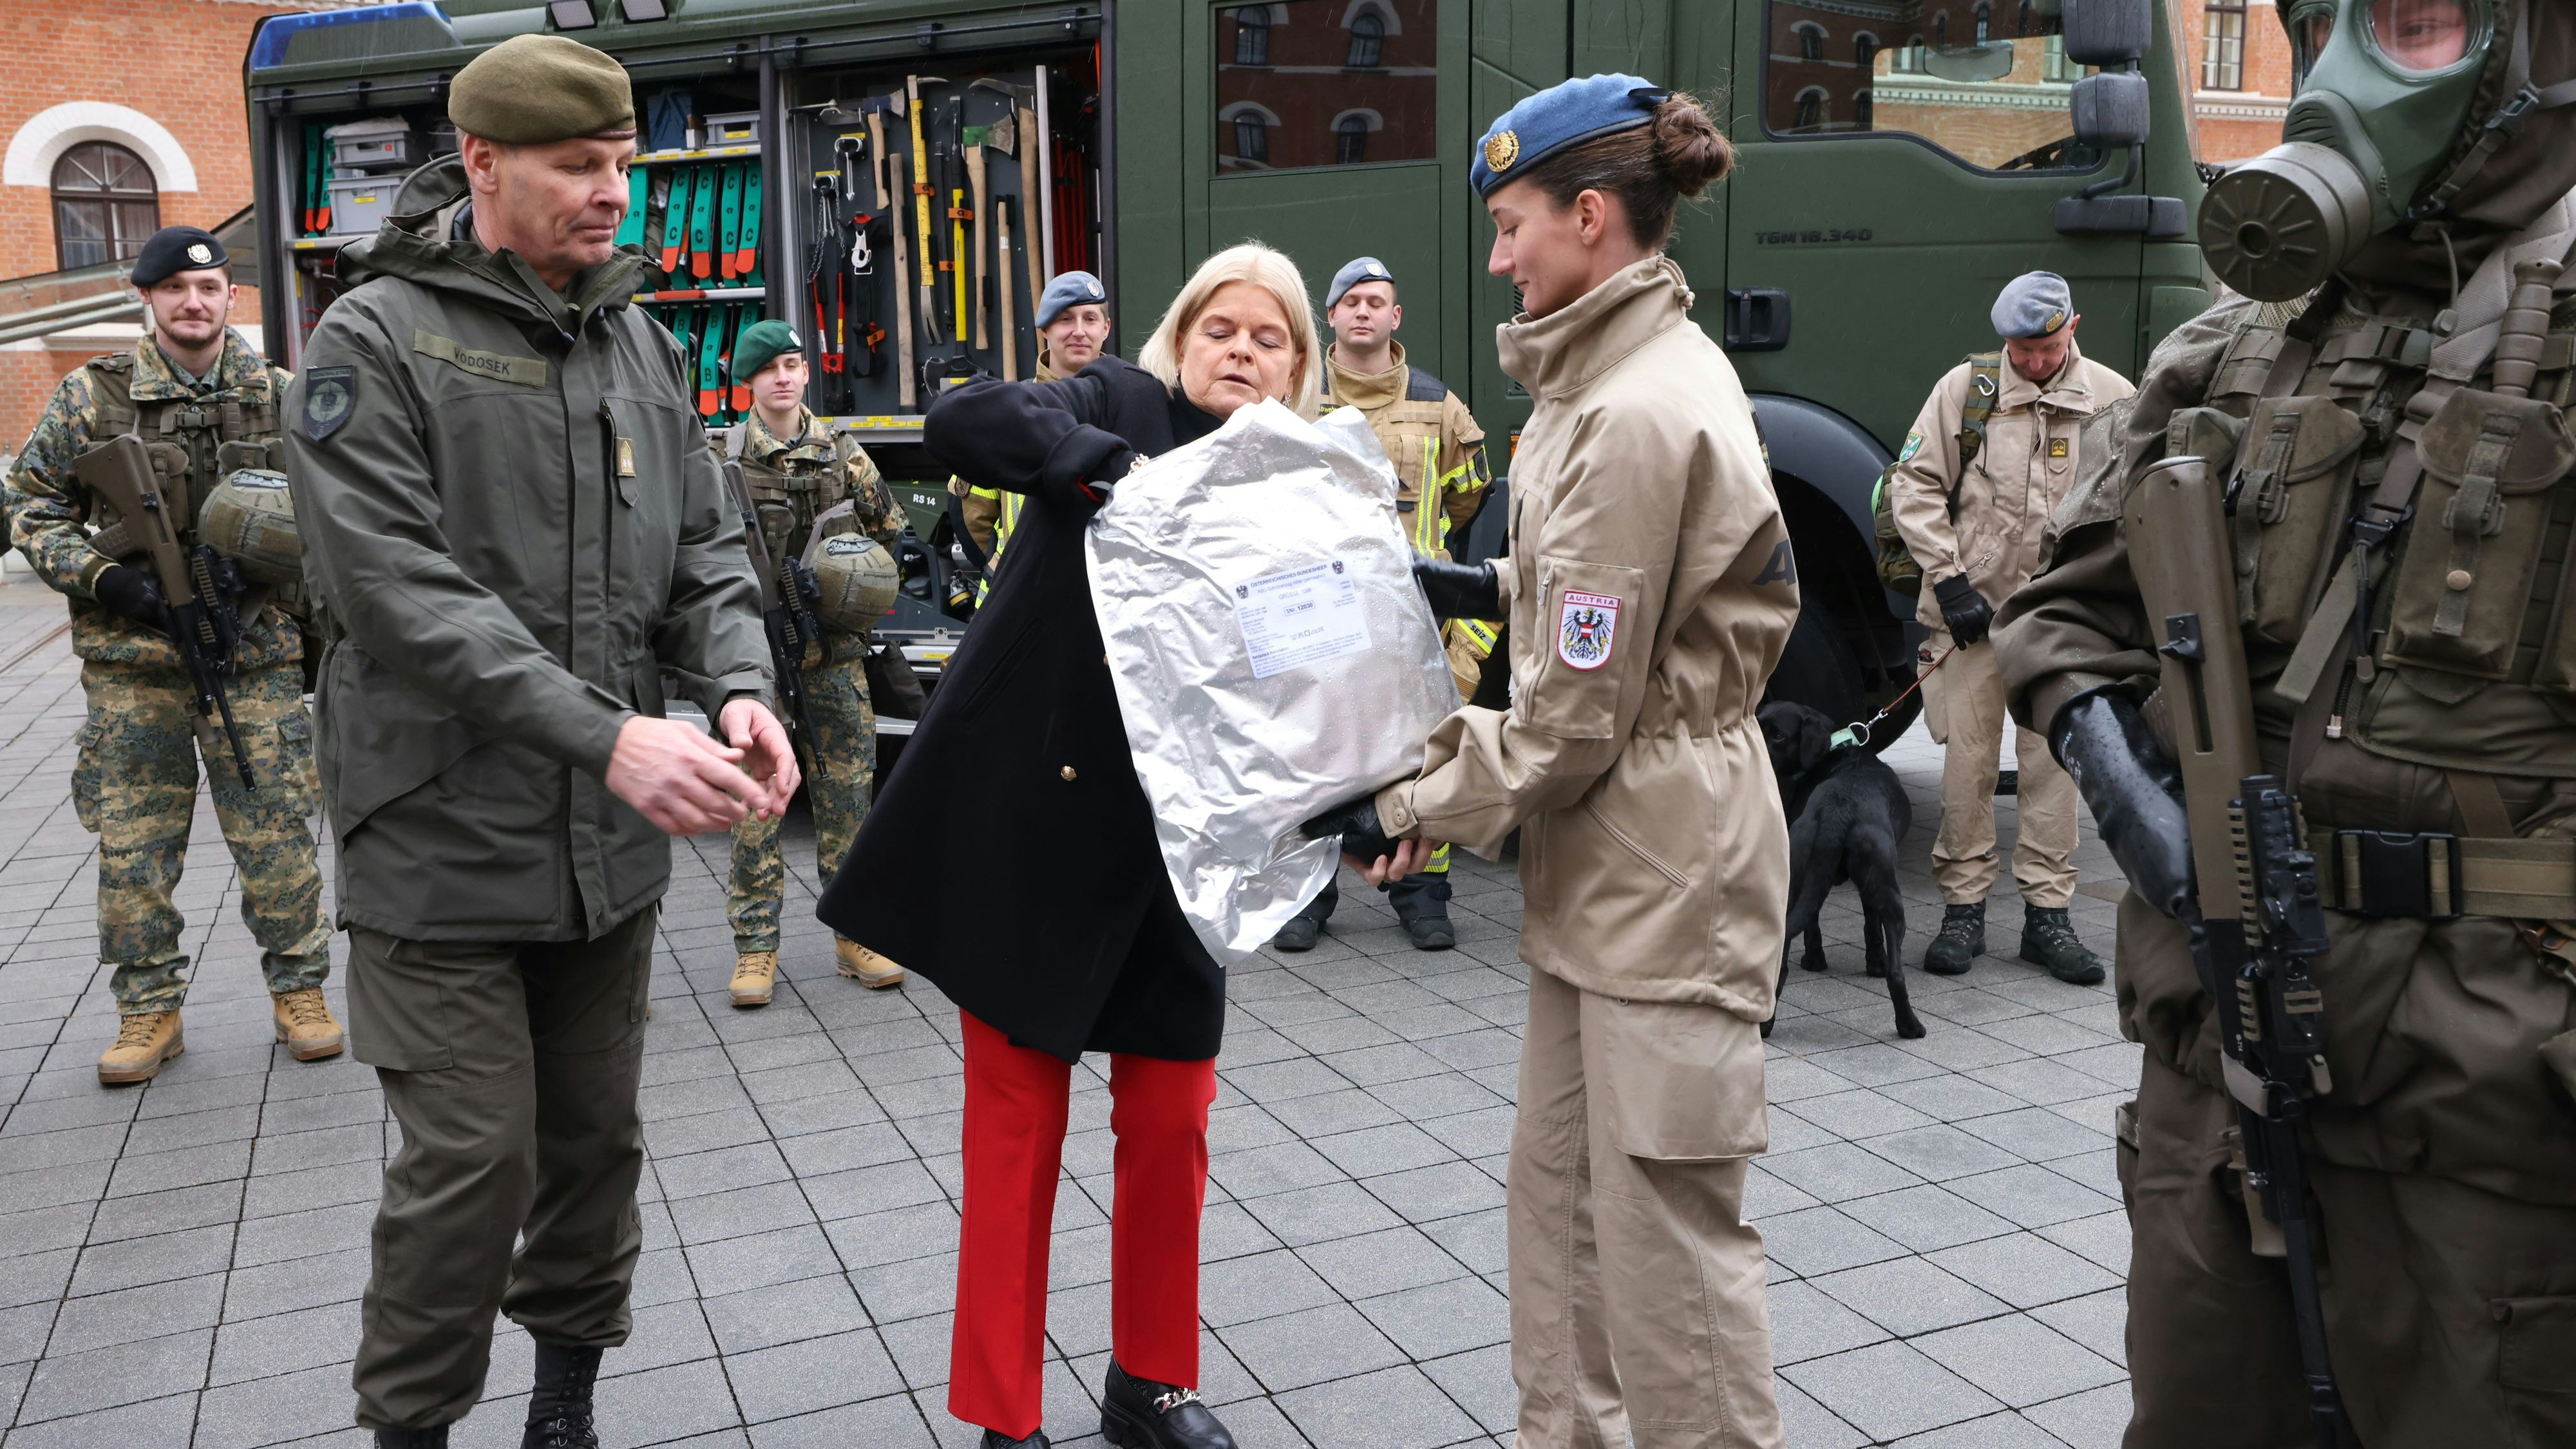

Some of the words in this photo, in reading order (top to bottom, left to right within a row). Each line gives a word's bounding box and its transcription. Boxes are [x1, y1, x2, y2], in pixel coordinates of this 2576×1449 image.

[454, 347, 510, 375] VODOSEK
[913, 494, 925, 504] RS
[927, 497, 936, 506] 14
[1296, 564, 1328, 578] BUNDESHEER
[1568, 594, 1615, 606] AUSTRIA
[1297, 602, 1314, 611] 12030
